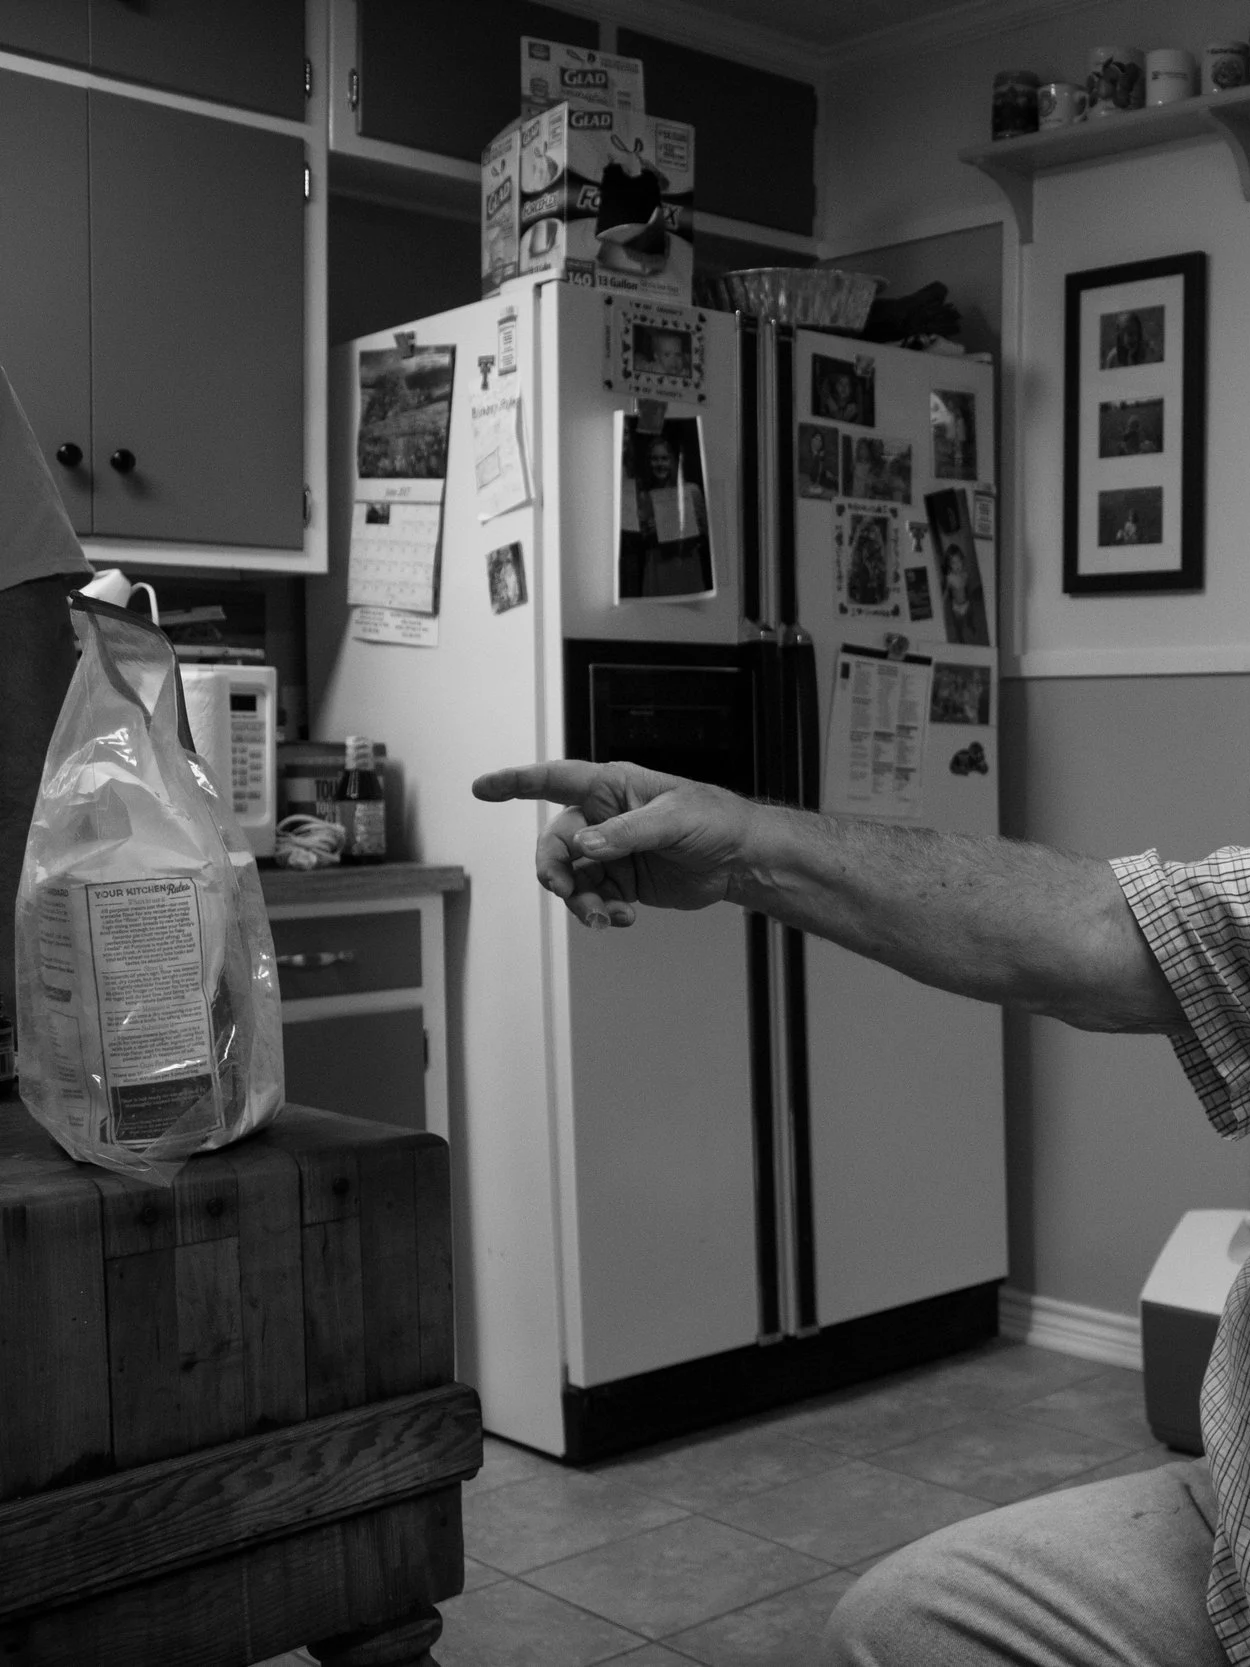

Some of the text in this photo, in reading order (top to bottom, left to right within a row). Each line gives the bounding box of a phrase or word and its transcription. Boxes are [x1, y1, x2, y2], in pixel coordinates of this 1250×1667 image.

[564, 69, 607, 85] GLAD
[570, 111, 611, 127] GLAD
[568, 271, 592, 287] 140
[610, 277, 638, 291] Gallon
[95, 888, 124, 900] YOUR
[126, 884, 167, 896] KITCHEN
